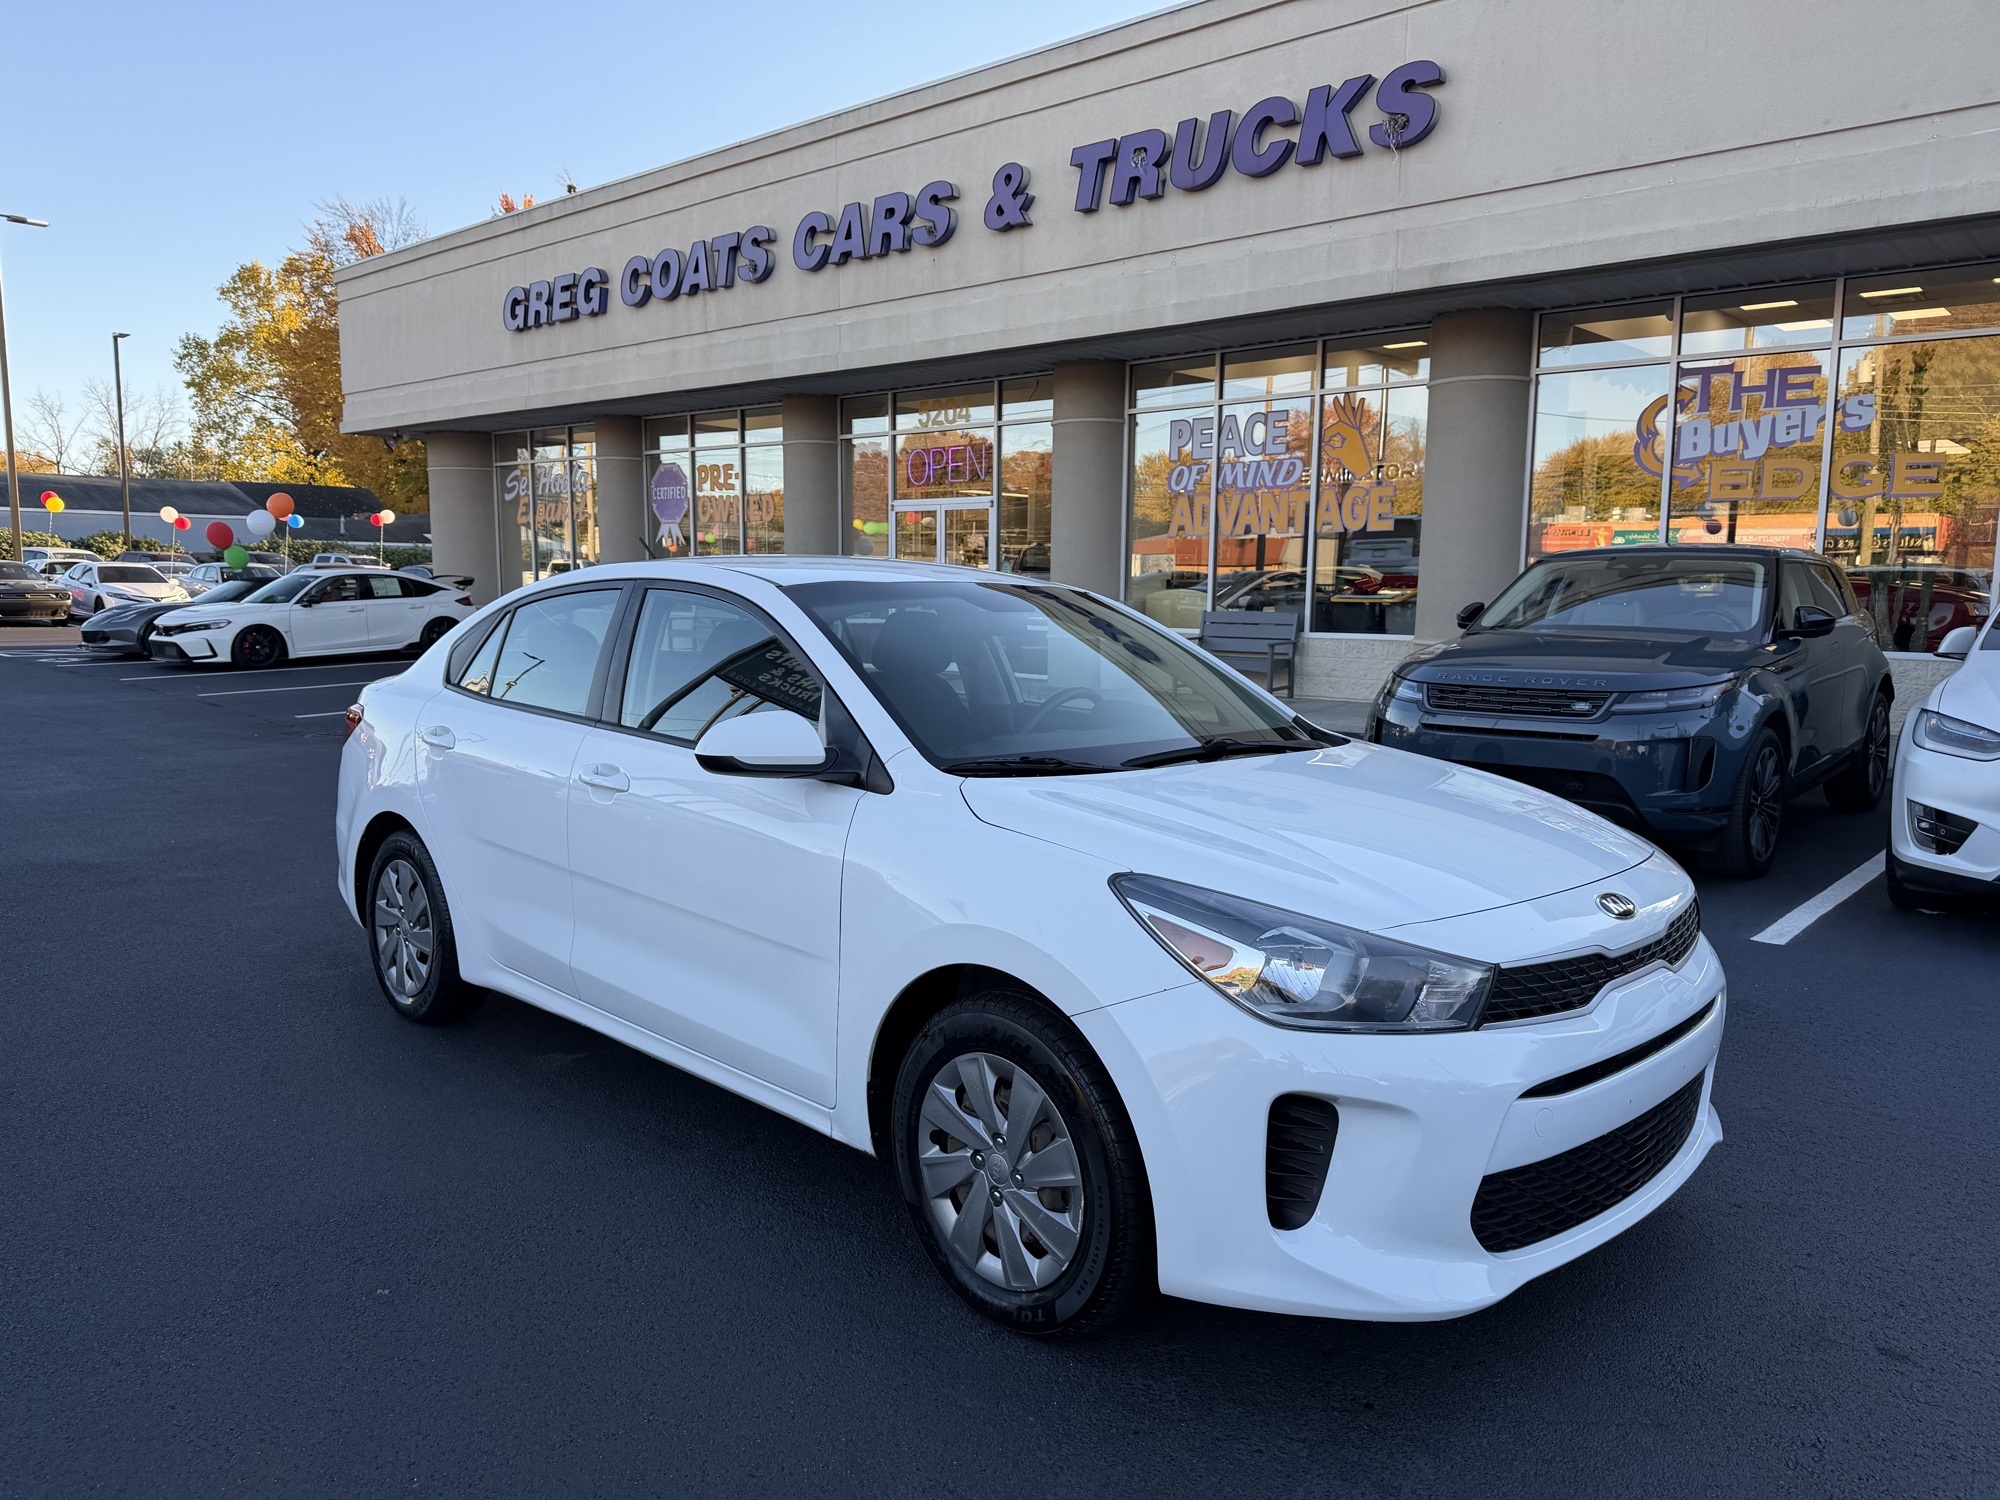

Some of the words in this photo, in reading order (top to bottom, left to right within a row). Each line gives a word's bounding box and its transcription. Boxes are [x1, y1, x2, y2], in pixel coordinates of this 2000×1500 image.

[503, 267, 609, 332] GREG
[620, 225, 777, 308] COATS
[792, 180, 960, 271] CARS
[983, 162, 1036, 232] &
[1069, 59, 1447, 213] TRUCKS
[1679, 362, 1823, 415] THE
[917, 398, 971, 428] 5204
[1169, 410, 1289, 462] PEACE
[504, 469, 528, 501] Se
[534, 463, 593, 495] Habla
[696, 463, 740, 492] PRE-
[907, 445, 987, 485] OPEN
[1168, 463, 1209, 493] OF
[1217, 457, 1305, 490] MIND
[1705, 451, 1947, 501] EDGE
[652, 485, 686, 500] CERTIFIED
[698, 493, 776, 523] OWNED
[1167, 485, 1397, 538] ADVANTAGE
[1436, 671, 1509, 683] RANGE
[1524, 676, 1608, 687] ROVER
